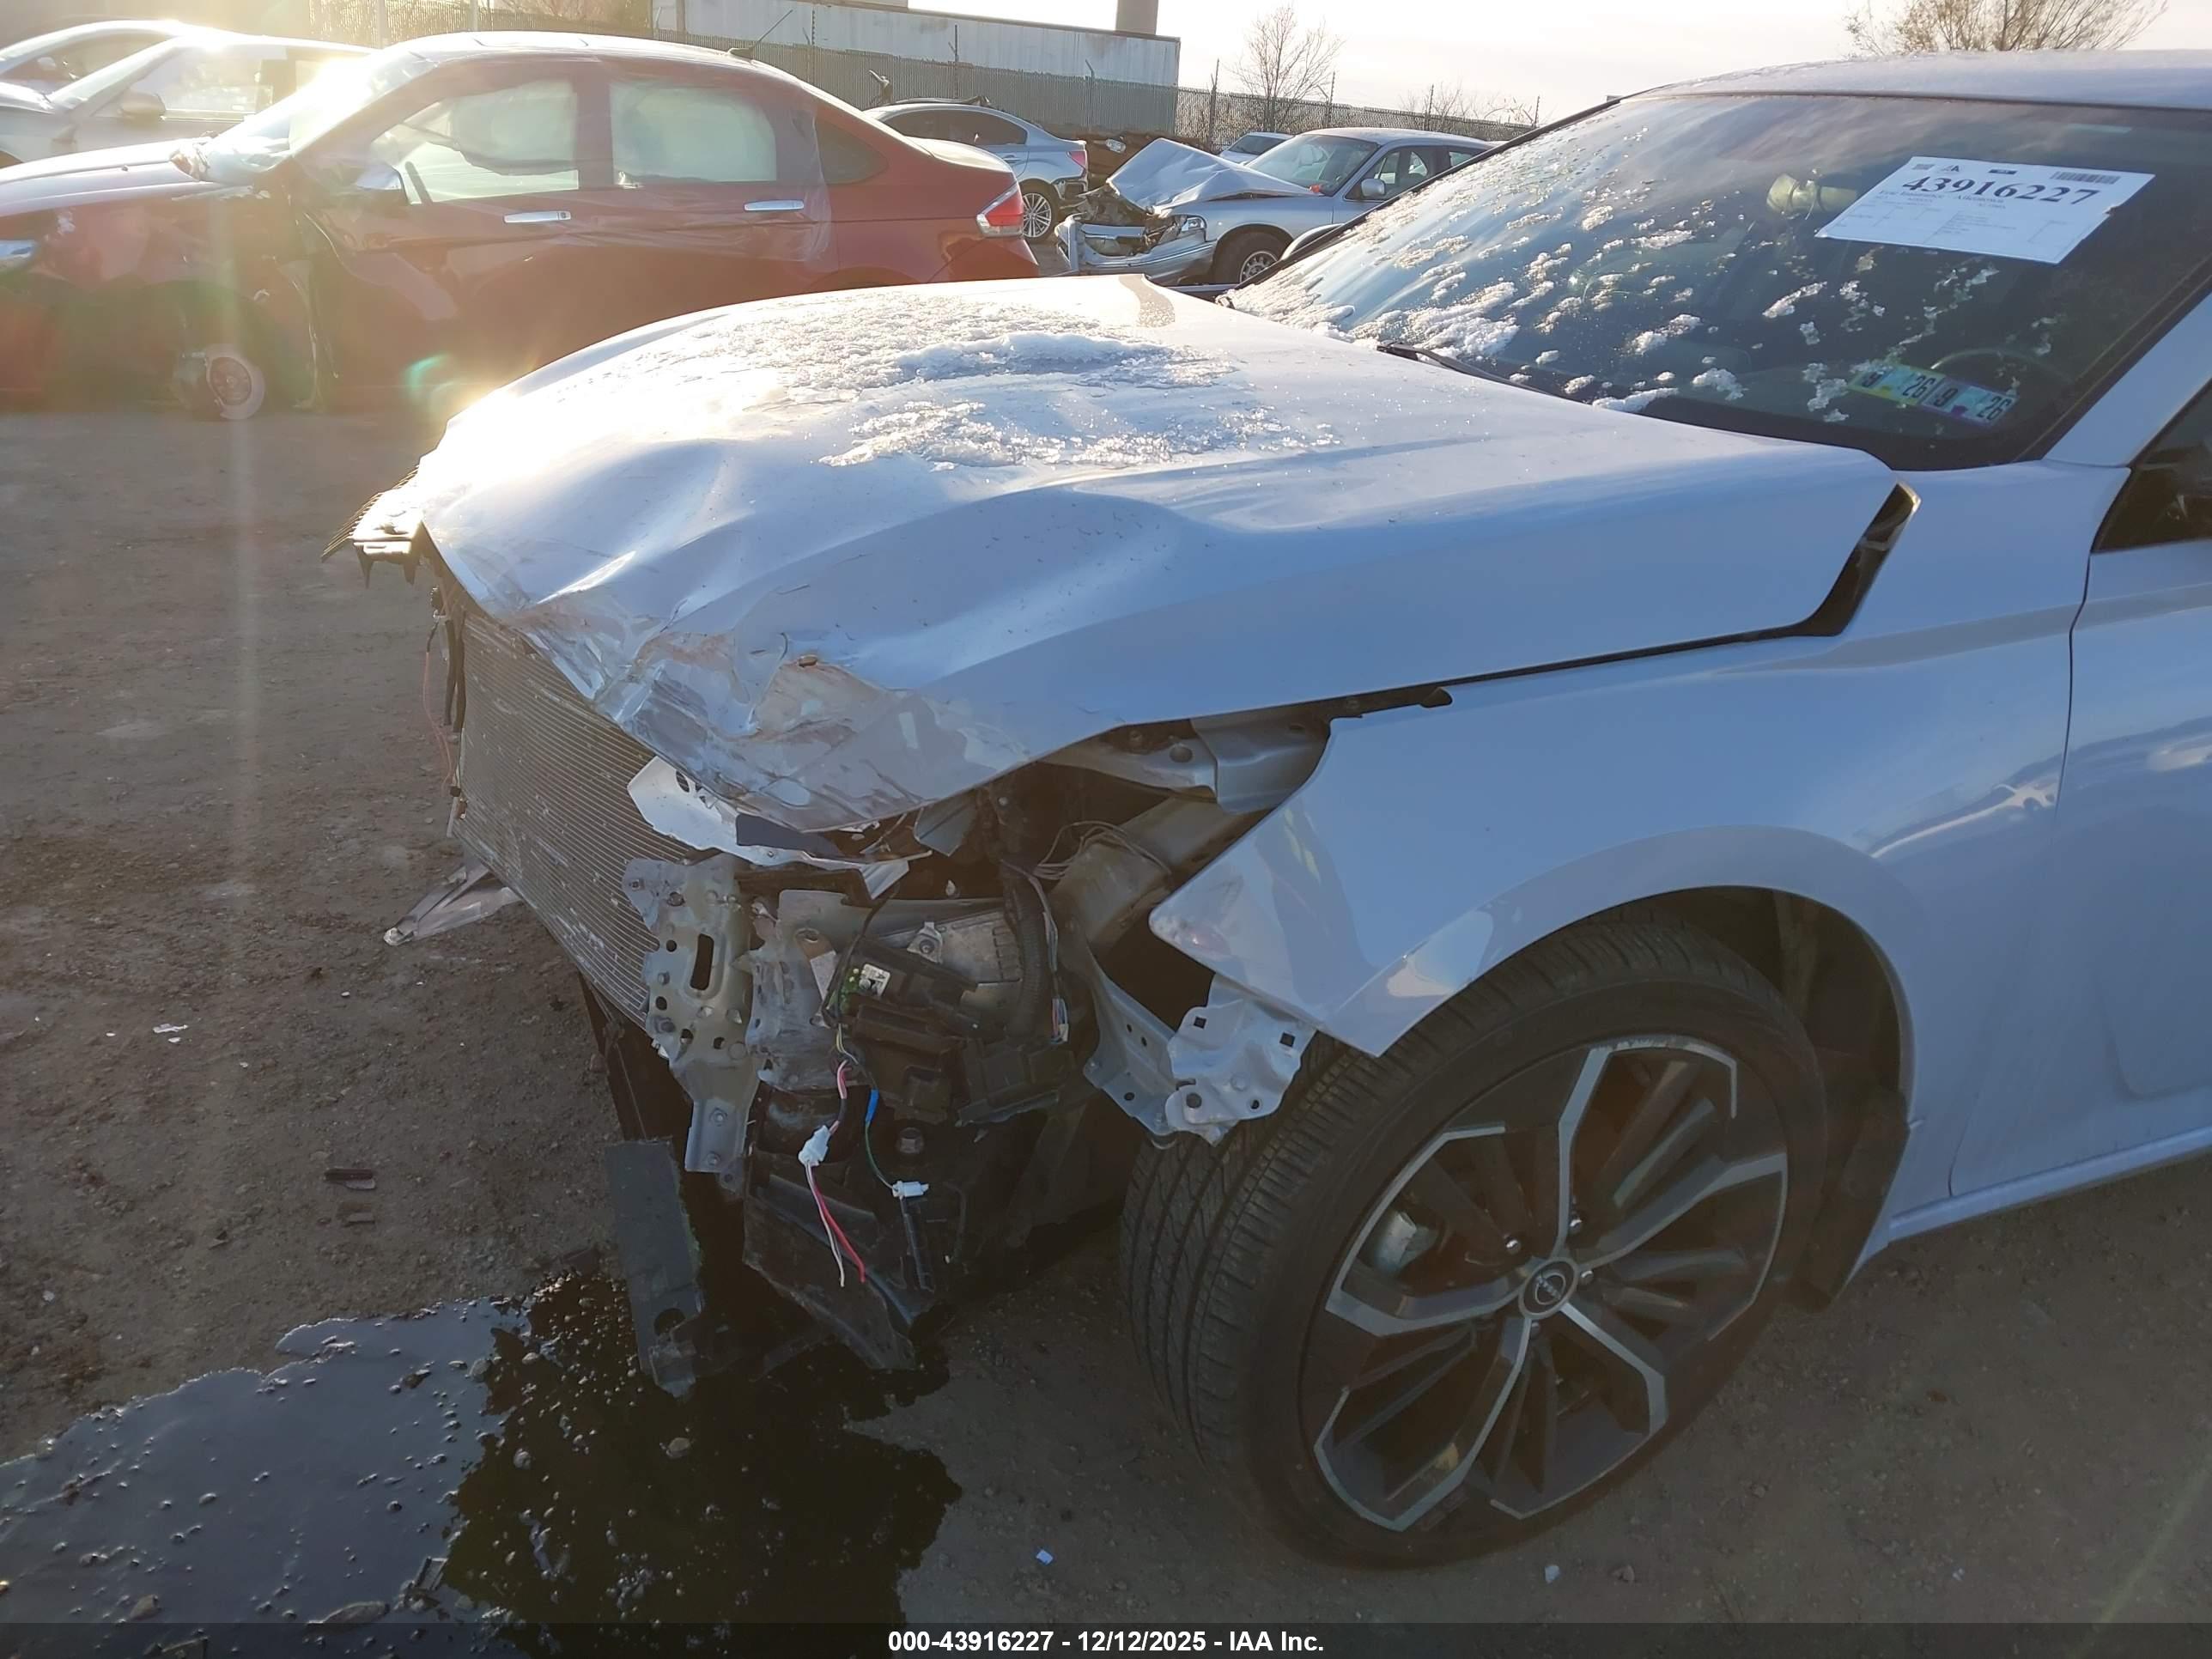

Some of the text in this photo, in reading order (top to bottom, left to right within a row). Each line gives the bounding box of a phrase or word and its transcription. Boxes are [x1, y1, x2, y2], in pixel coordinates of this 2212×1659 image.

[1903, 176, 2101, 205] 43916227
[1902, 374, 1936, 398] 26
[1934, 388, 2009, 421] 9 26
